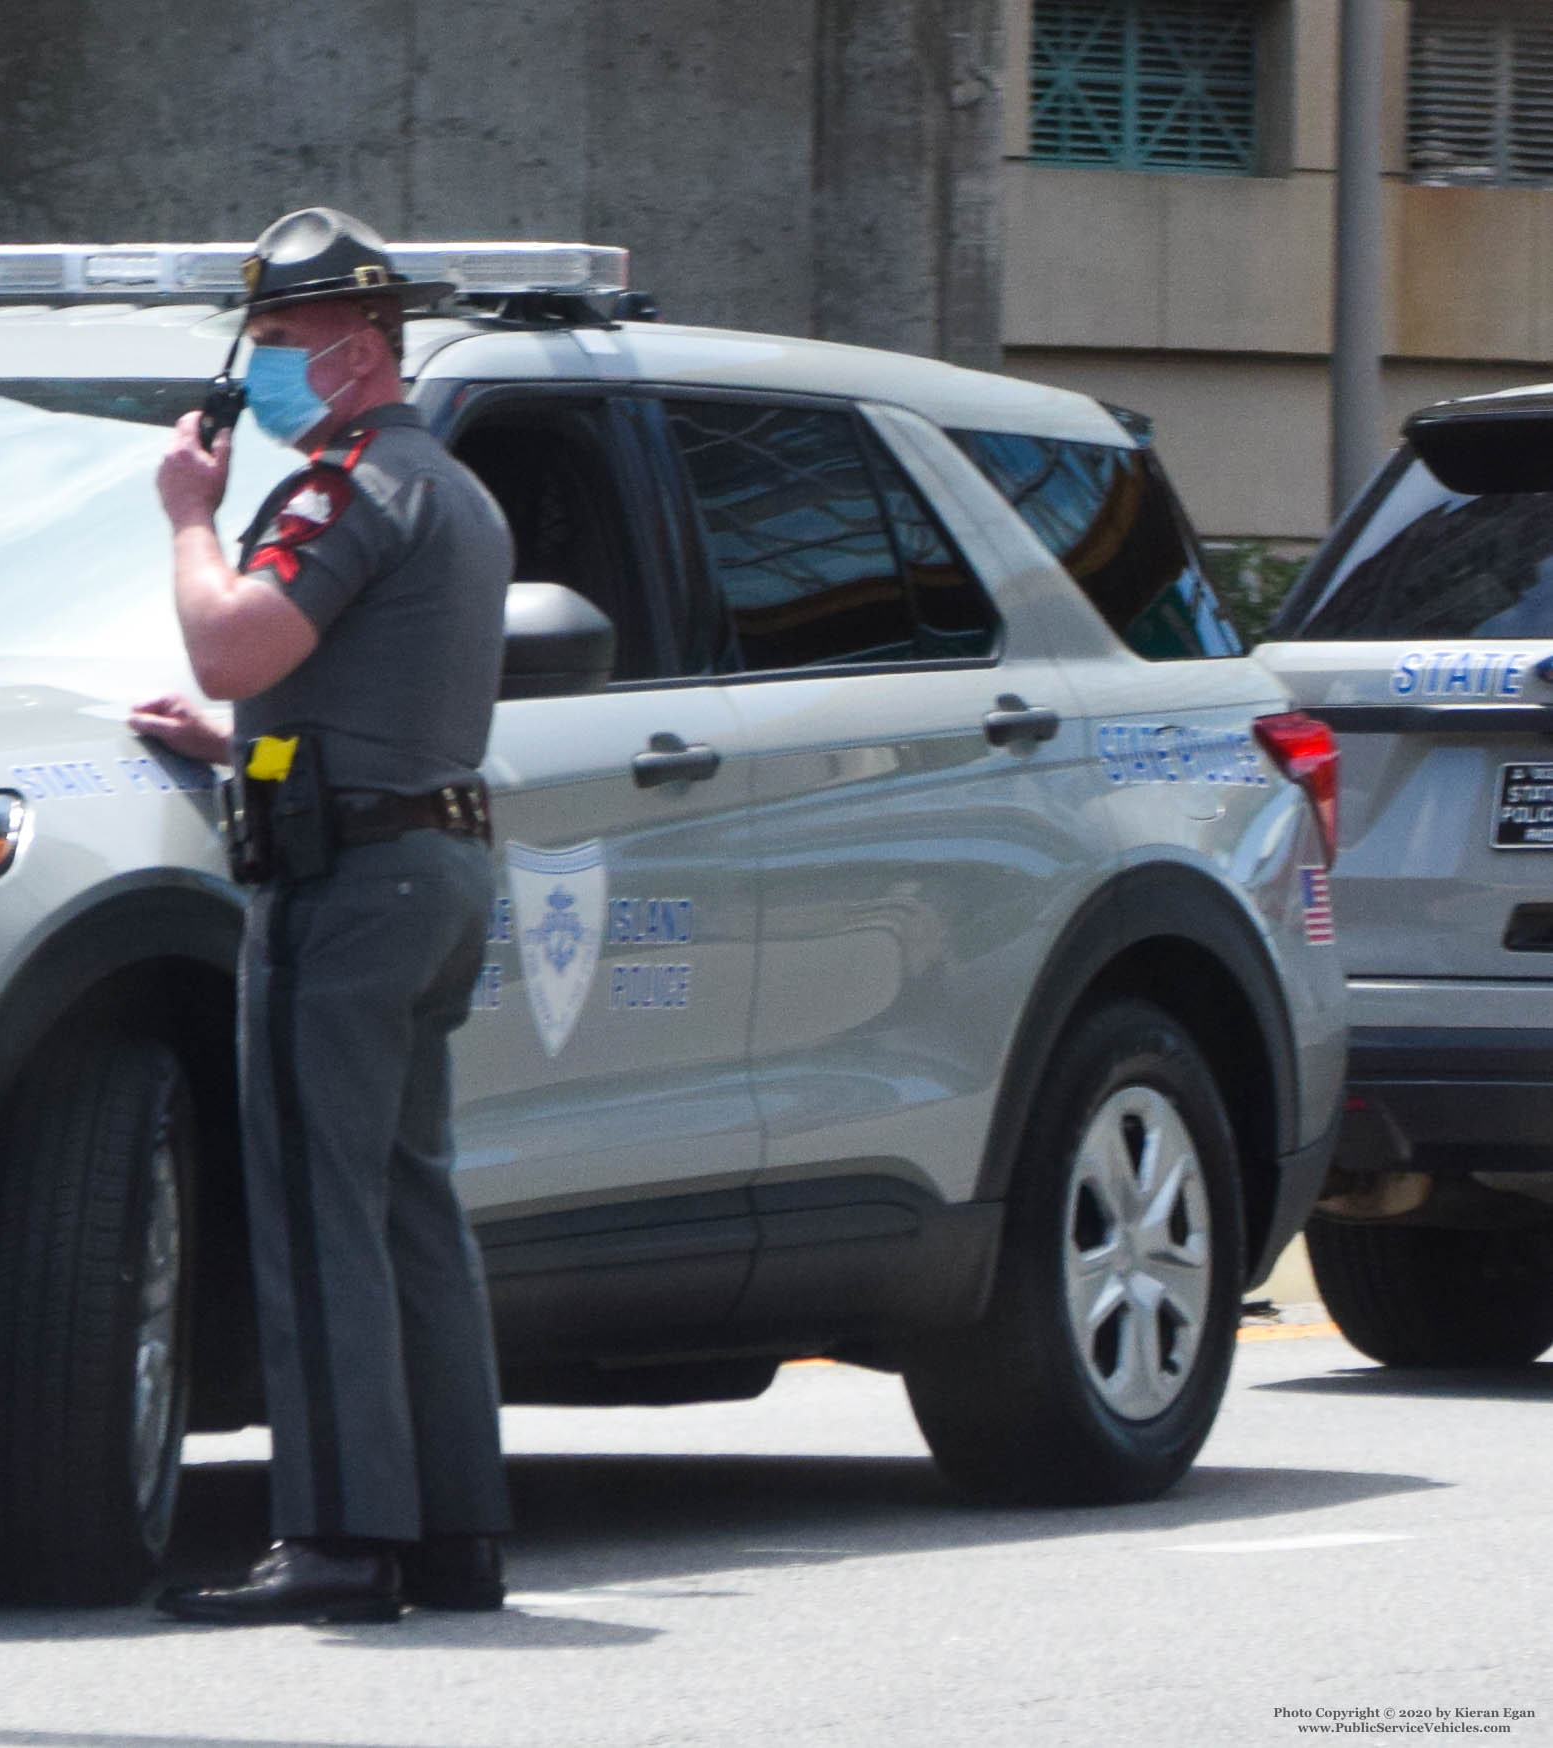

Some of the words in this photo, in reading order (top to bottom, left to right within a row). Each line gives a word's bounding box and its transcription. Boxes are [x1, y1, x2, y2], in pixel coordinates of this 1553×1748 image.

[1390, 651, 1531, 697] STATE
[10, 760, 114, 801] STATE
[607, 897, 692, 945] ISLAND
[611, 963, 692, 1010] POLICE
